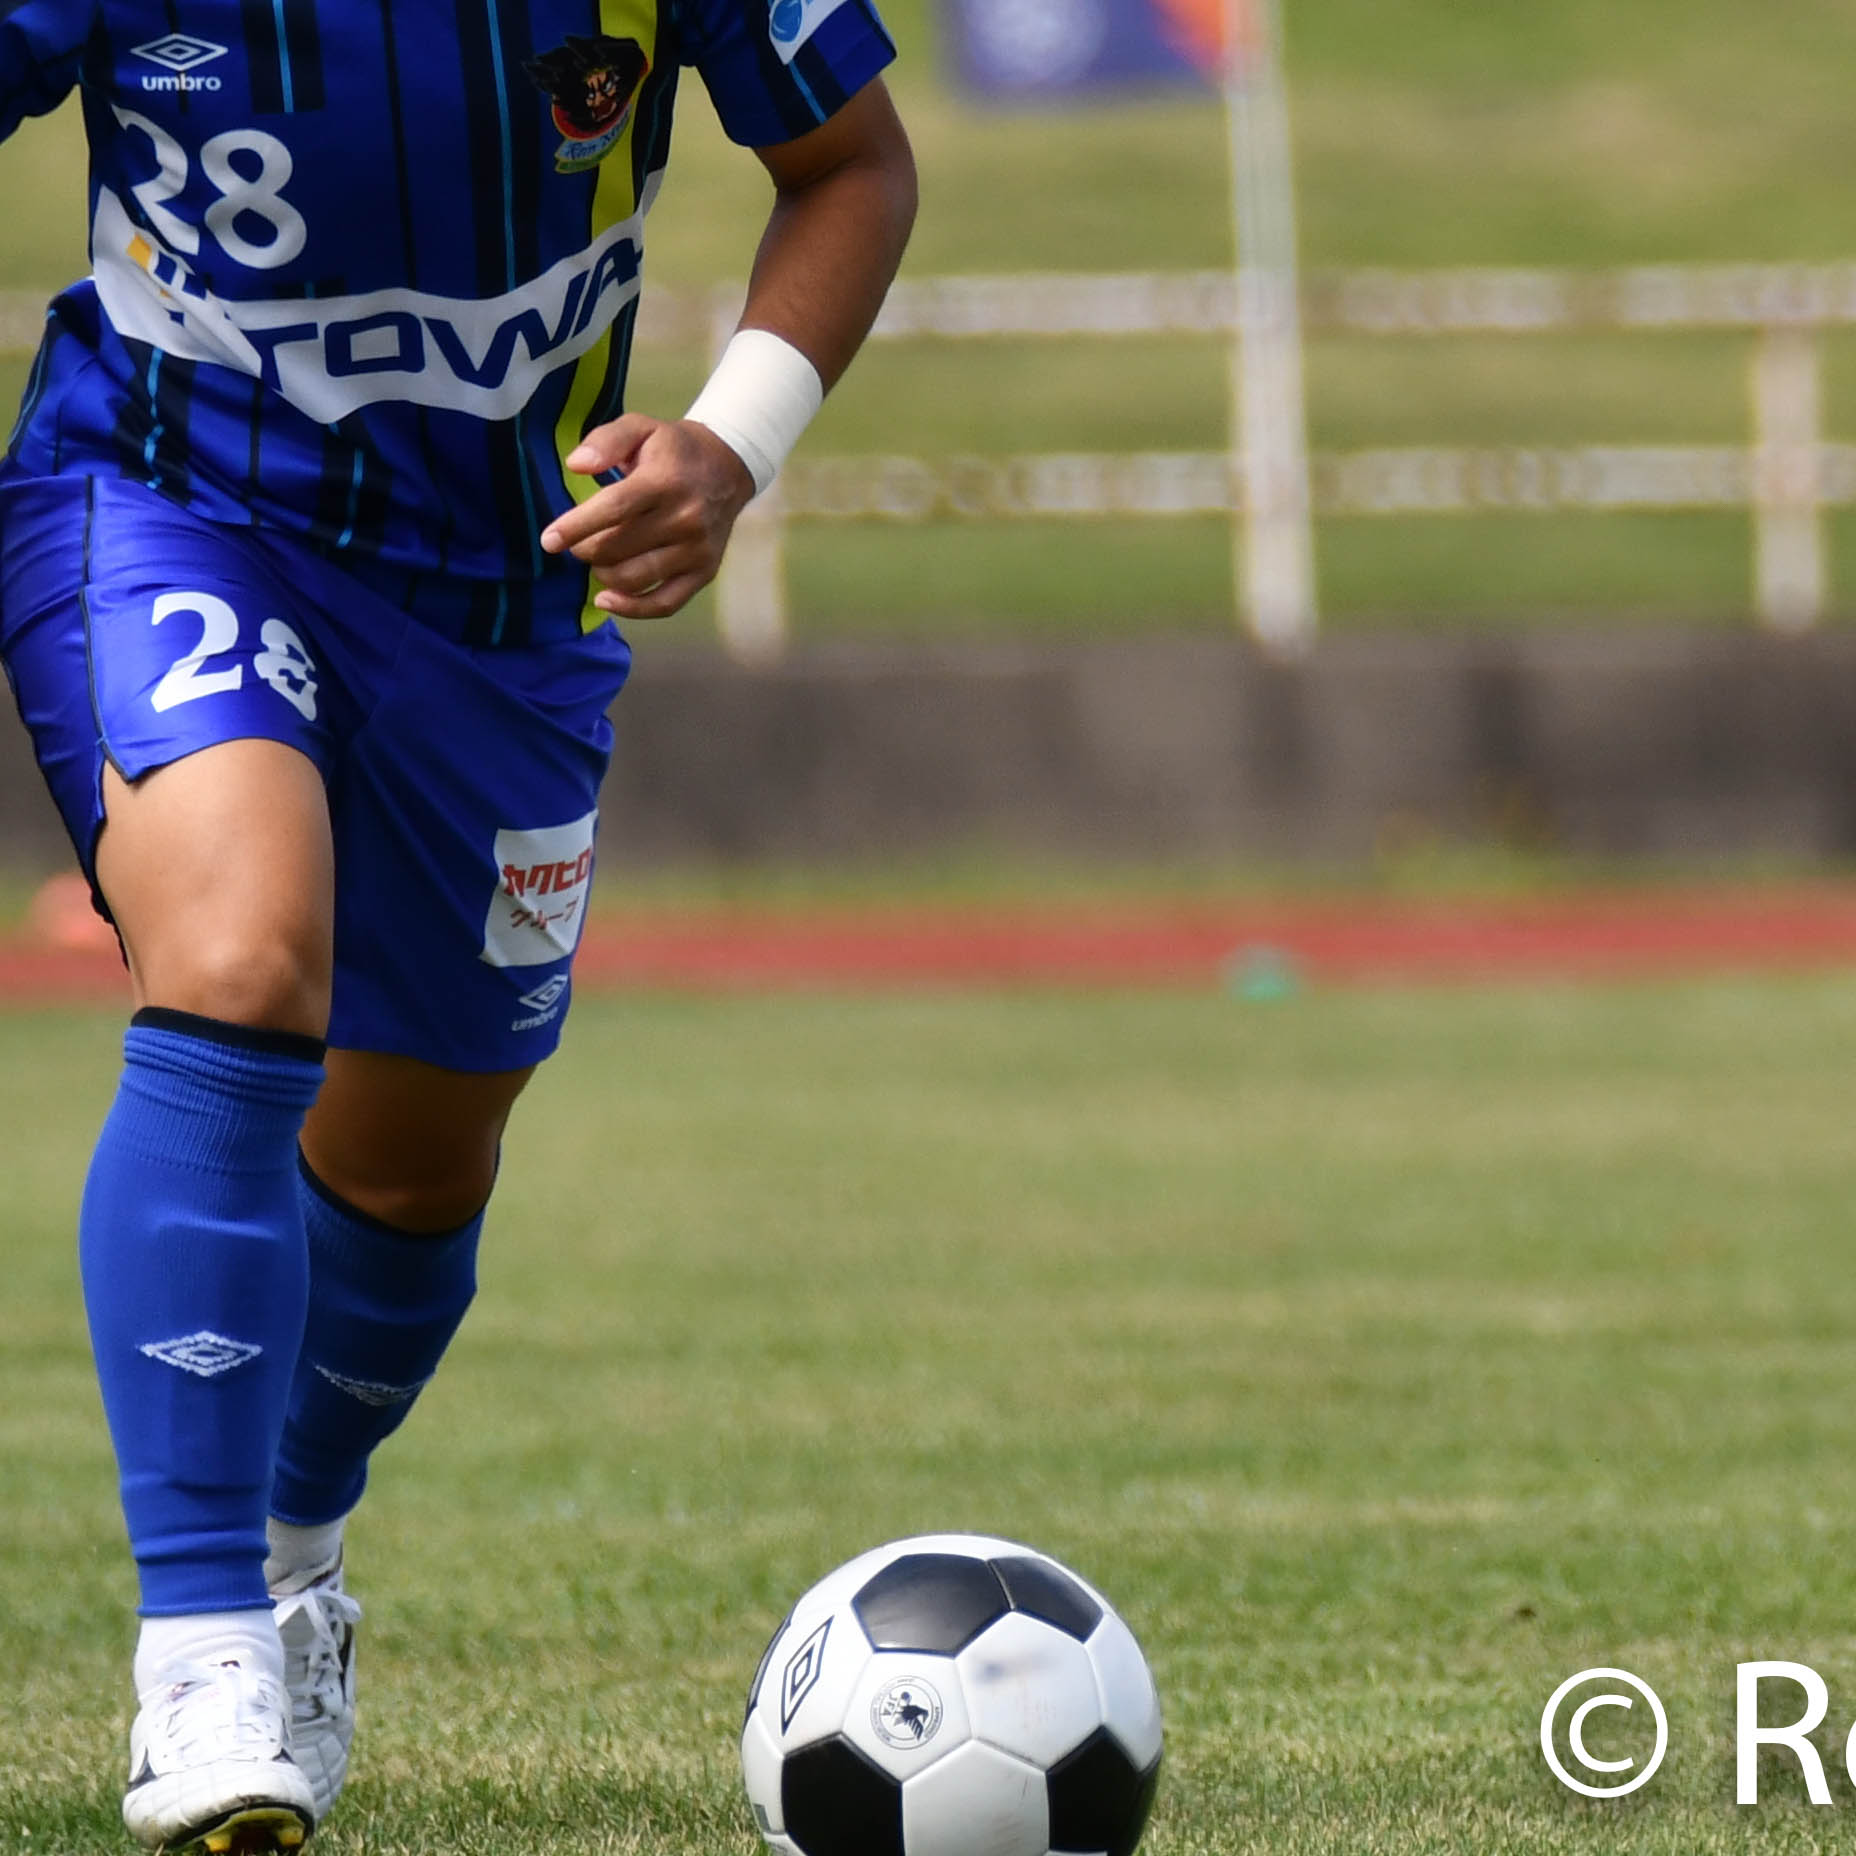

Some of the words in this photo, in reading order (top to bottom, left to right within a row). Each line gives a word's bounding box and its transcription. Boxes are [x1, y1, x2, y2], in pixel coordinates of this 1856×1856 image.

[141, 73, 222, 91] umbro
[110, 103, 307, 270] 28
[150, 591, 318, 722] 28
[502, 847, 593, 898] カクヒロ
